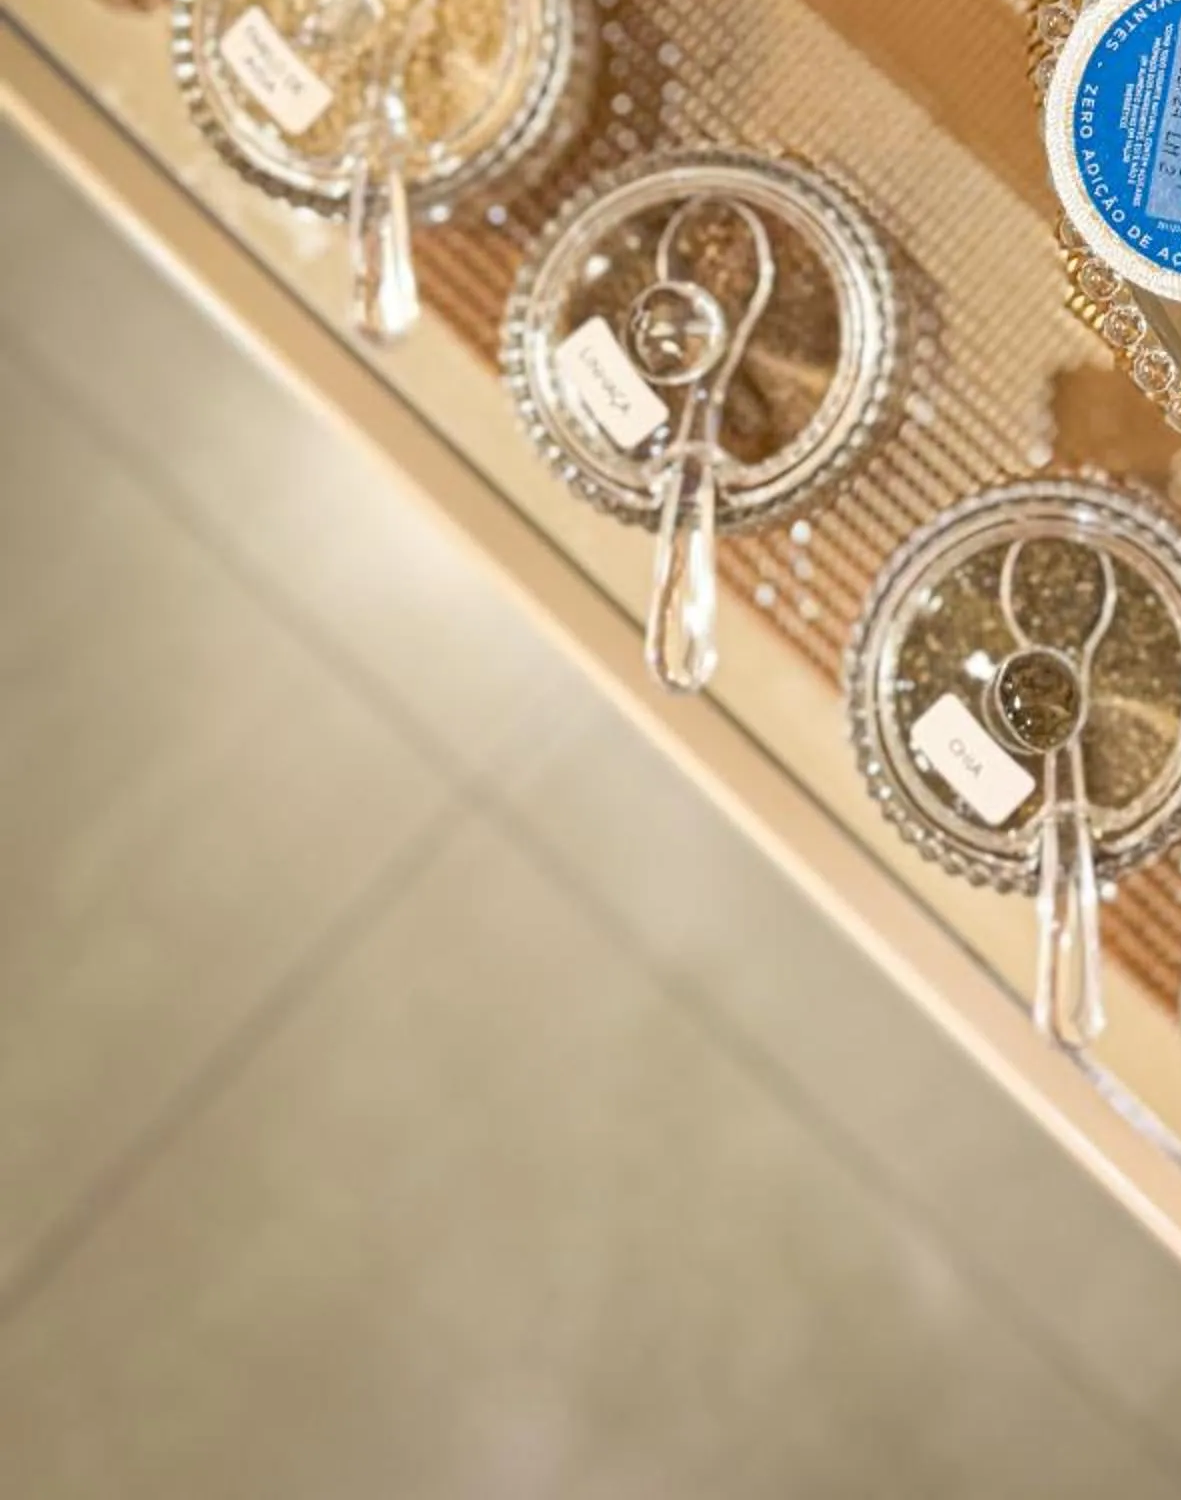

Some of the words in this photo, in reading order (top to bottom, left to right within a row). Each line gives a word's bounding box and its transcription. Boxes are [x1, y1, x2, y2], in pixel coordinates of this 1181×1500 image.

[1078, 83, 1100, 140] ZERO
[1081, 150, 1127, 224] ADIÇÃO
[1126, 225, 1153, 249] DE
